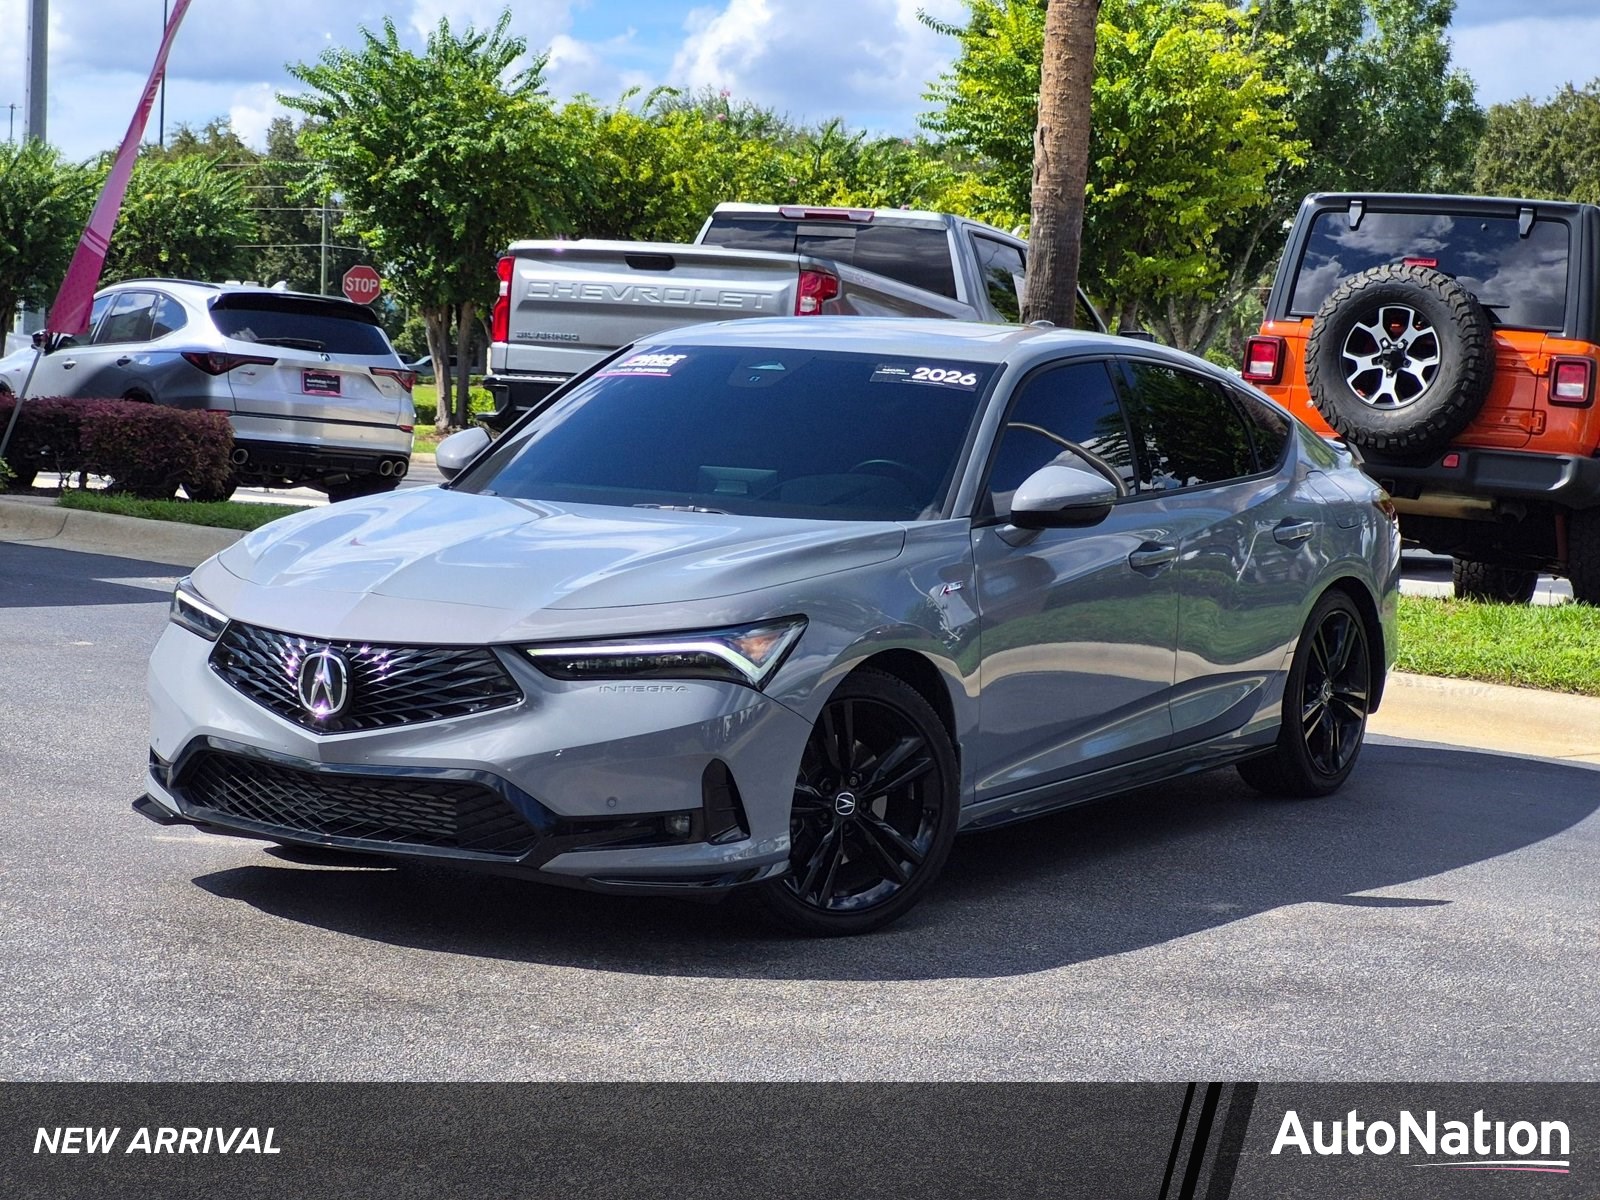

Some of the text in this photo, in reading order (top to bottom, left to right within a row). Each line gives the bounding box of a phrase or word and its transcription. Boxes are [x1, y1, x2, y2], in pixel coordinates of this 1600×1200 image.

[345, 277, 378, 293] STOP
[526, 281, 774, 310] CHEVROLET
[911, 366, 978, 386] 2026
[598, 684, 690, 694] INTEGRA
